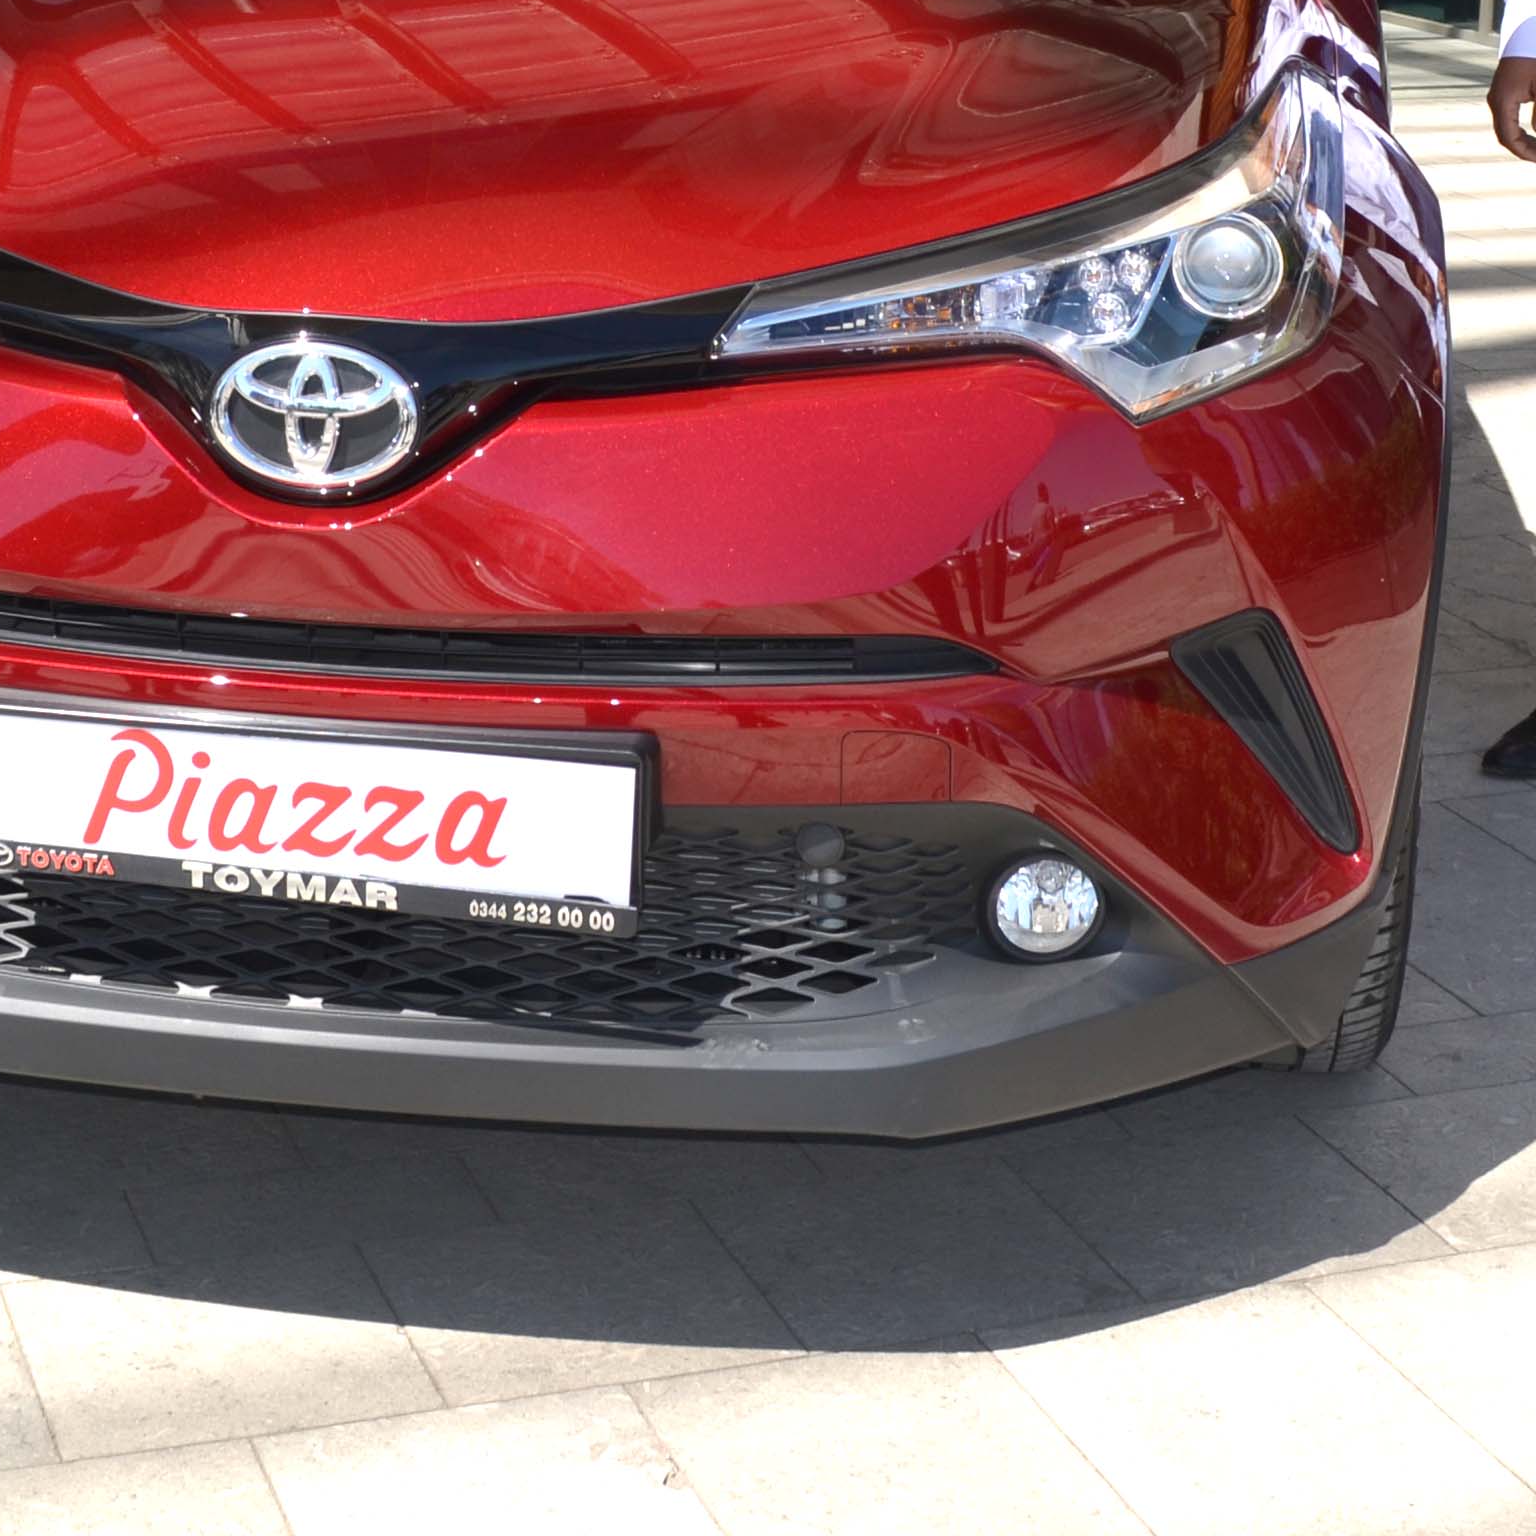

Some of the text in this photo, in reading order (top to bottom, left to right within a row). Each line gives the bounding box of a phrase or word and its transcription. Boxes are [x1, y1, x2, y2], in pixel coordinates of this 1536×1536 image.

[81, 727, 509, 870] Piazza
[17, 845, 616, 933] TOYOTA TOYMAR 0344 232 00 00
